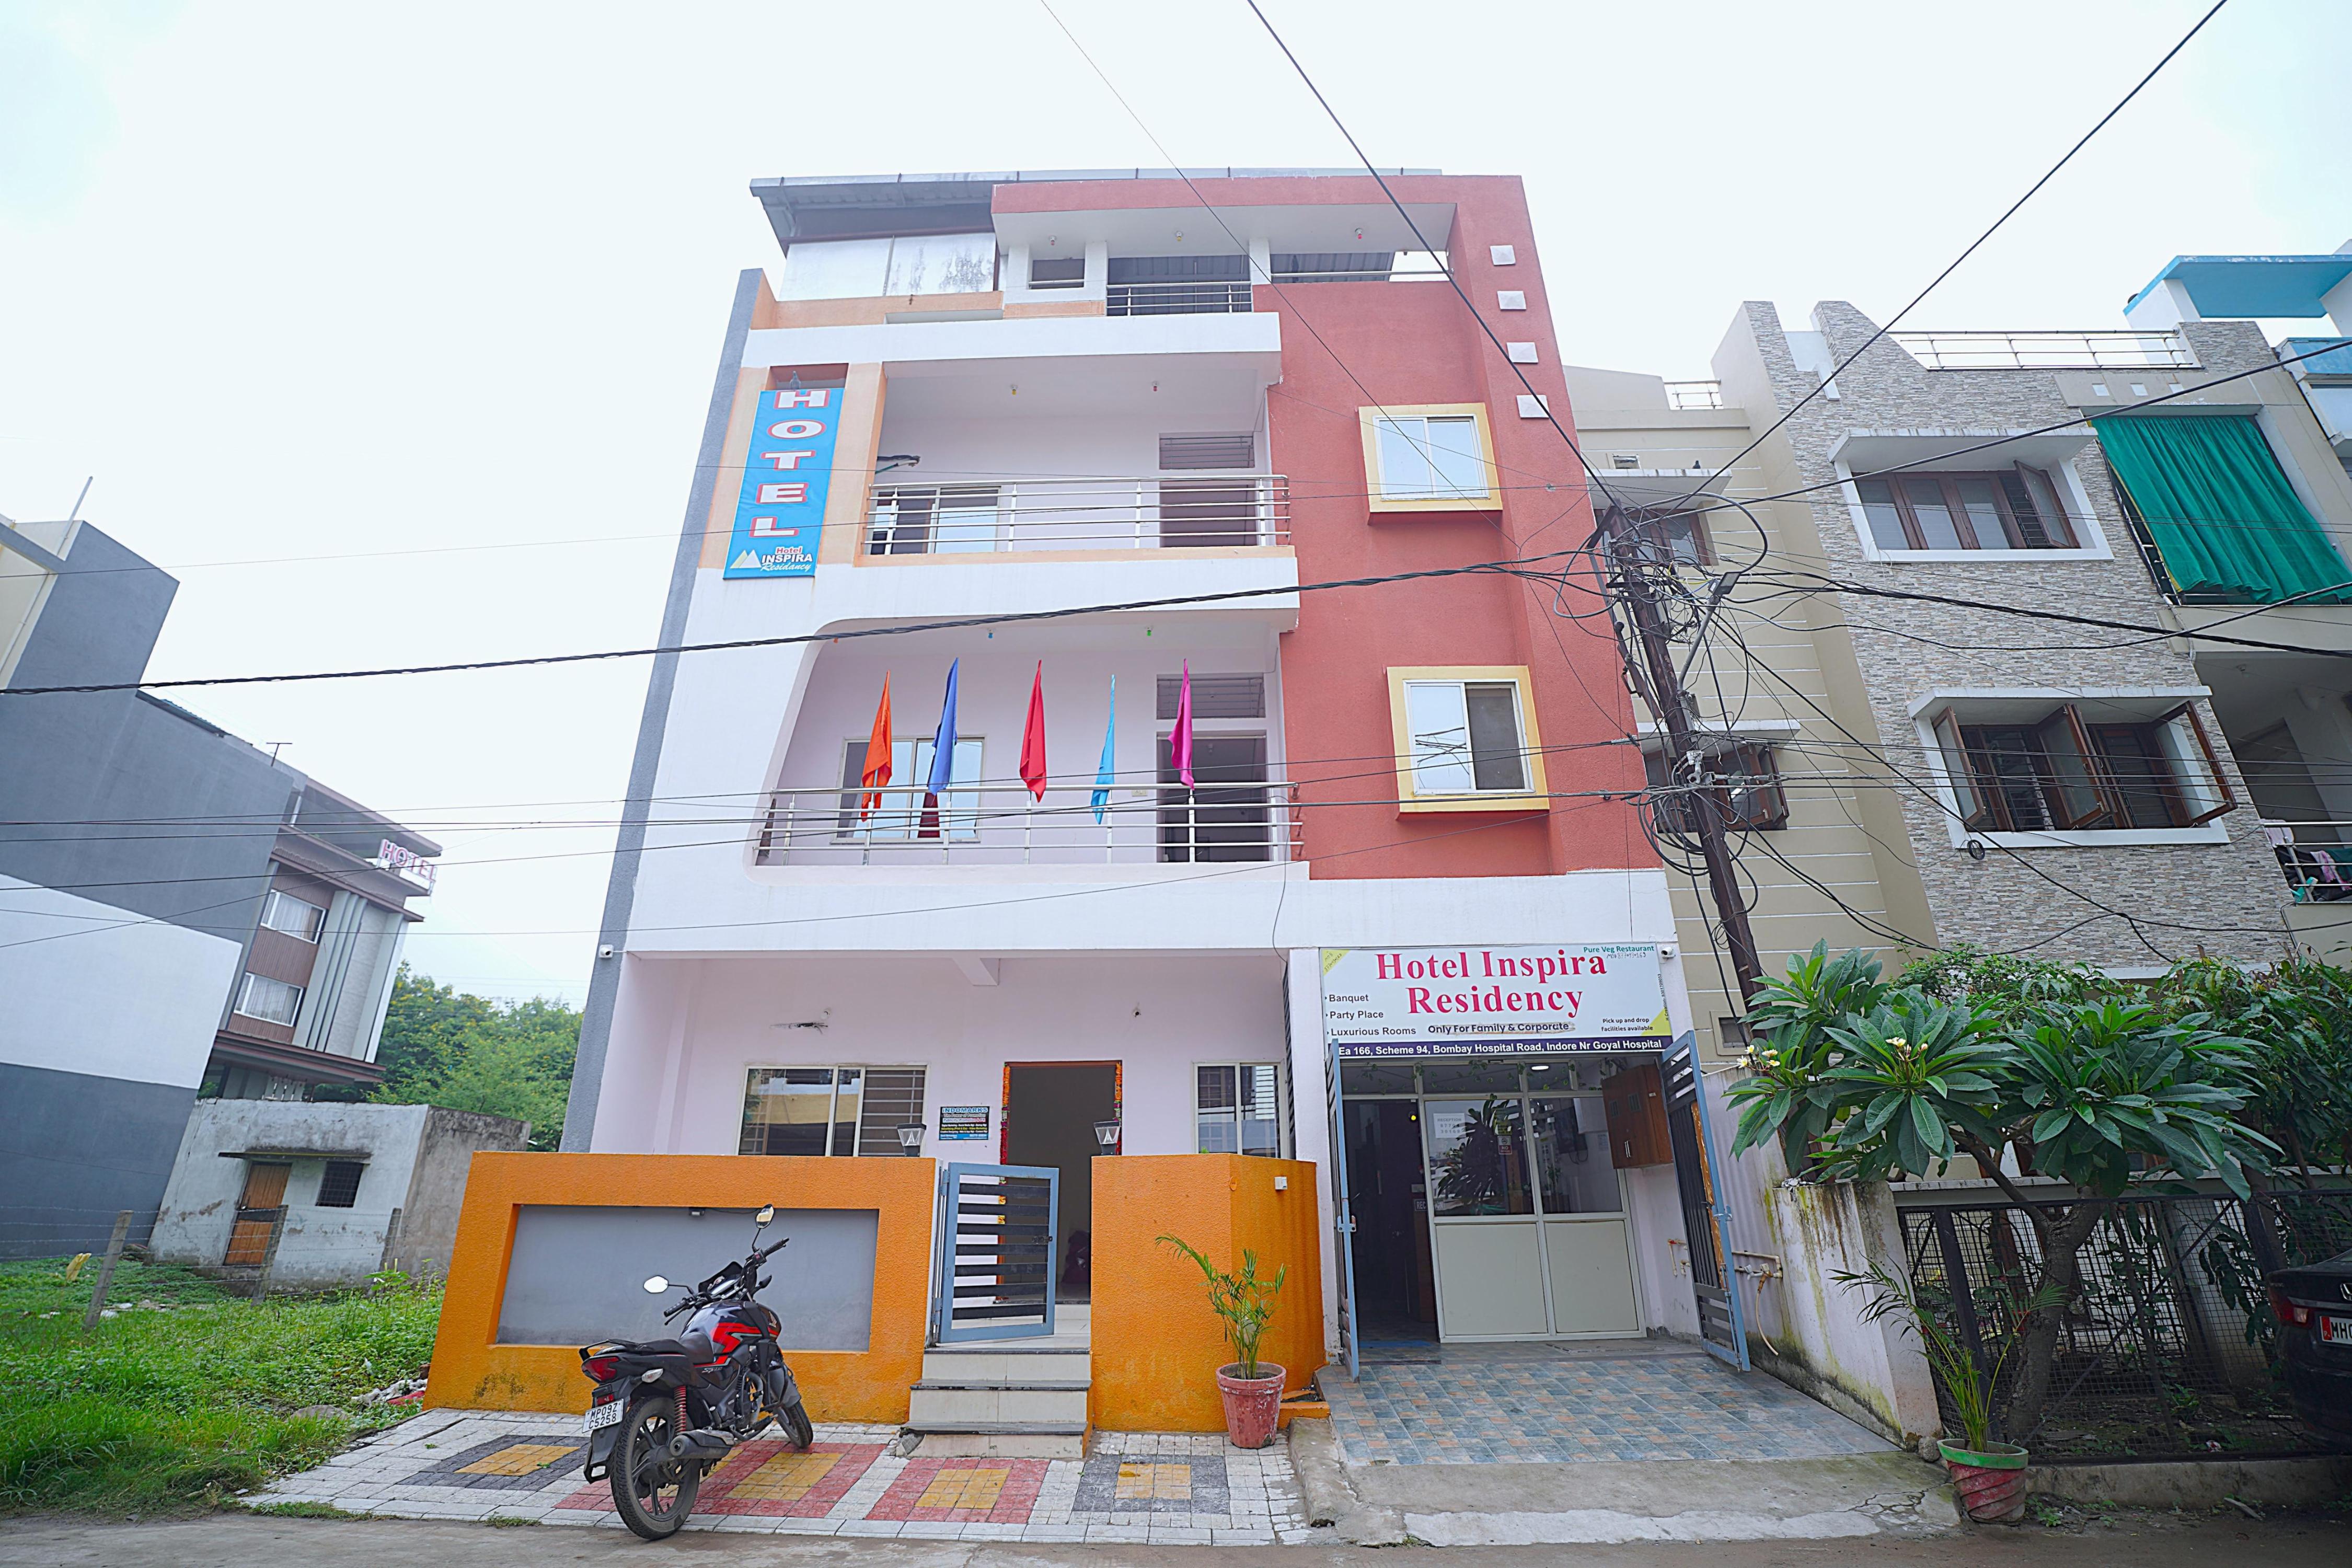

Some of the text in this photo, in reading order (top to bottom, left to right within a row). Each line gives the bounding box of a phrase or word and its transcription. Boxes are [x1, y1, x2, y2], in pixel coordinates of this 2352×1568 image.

[750, 389, 831, 538] HOTEL
[775, 546, 803, 555] Hotel
[761, 554, 813, 564] INSPIRA
[379, 839, 436, 883] HOTEL
[1376, 949, 1608, 984] Hotel Inspira
[1329, 995, 1368, 1003] Banquet
[1406, 985, 1583, 1018] Residency
[1330, 1011, 1354, 1020] Party
[1428, 1025, 1451, 1035] Only
[1471, 1023, 1505, 1033] Family
[1518, 1022, 1569, 1032] Corporate
[1339, 1047, 1351, 1055] Ea
[1354, 1047, 1373, 1056] 166,
[1376, 1046, 1414, 1055] Scheme
[1416, 1046, 1431, 1055] 94,
[1433, 1045, 1472, 1054] Bombay
[1475, 1043, 1514, 1053] Hospital
[1517, 1042, 1544, 1052] Road,
[1547, 1042, 1577, 1051] Indore
[1593, 1041, 1620, 1051] Goyal
[1623, 1040, 1662, 1050] Hospital
[591, 1403, 618, 1420] MP09Z
[589, 1413, 617, 1429] C5258
